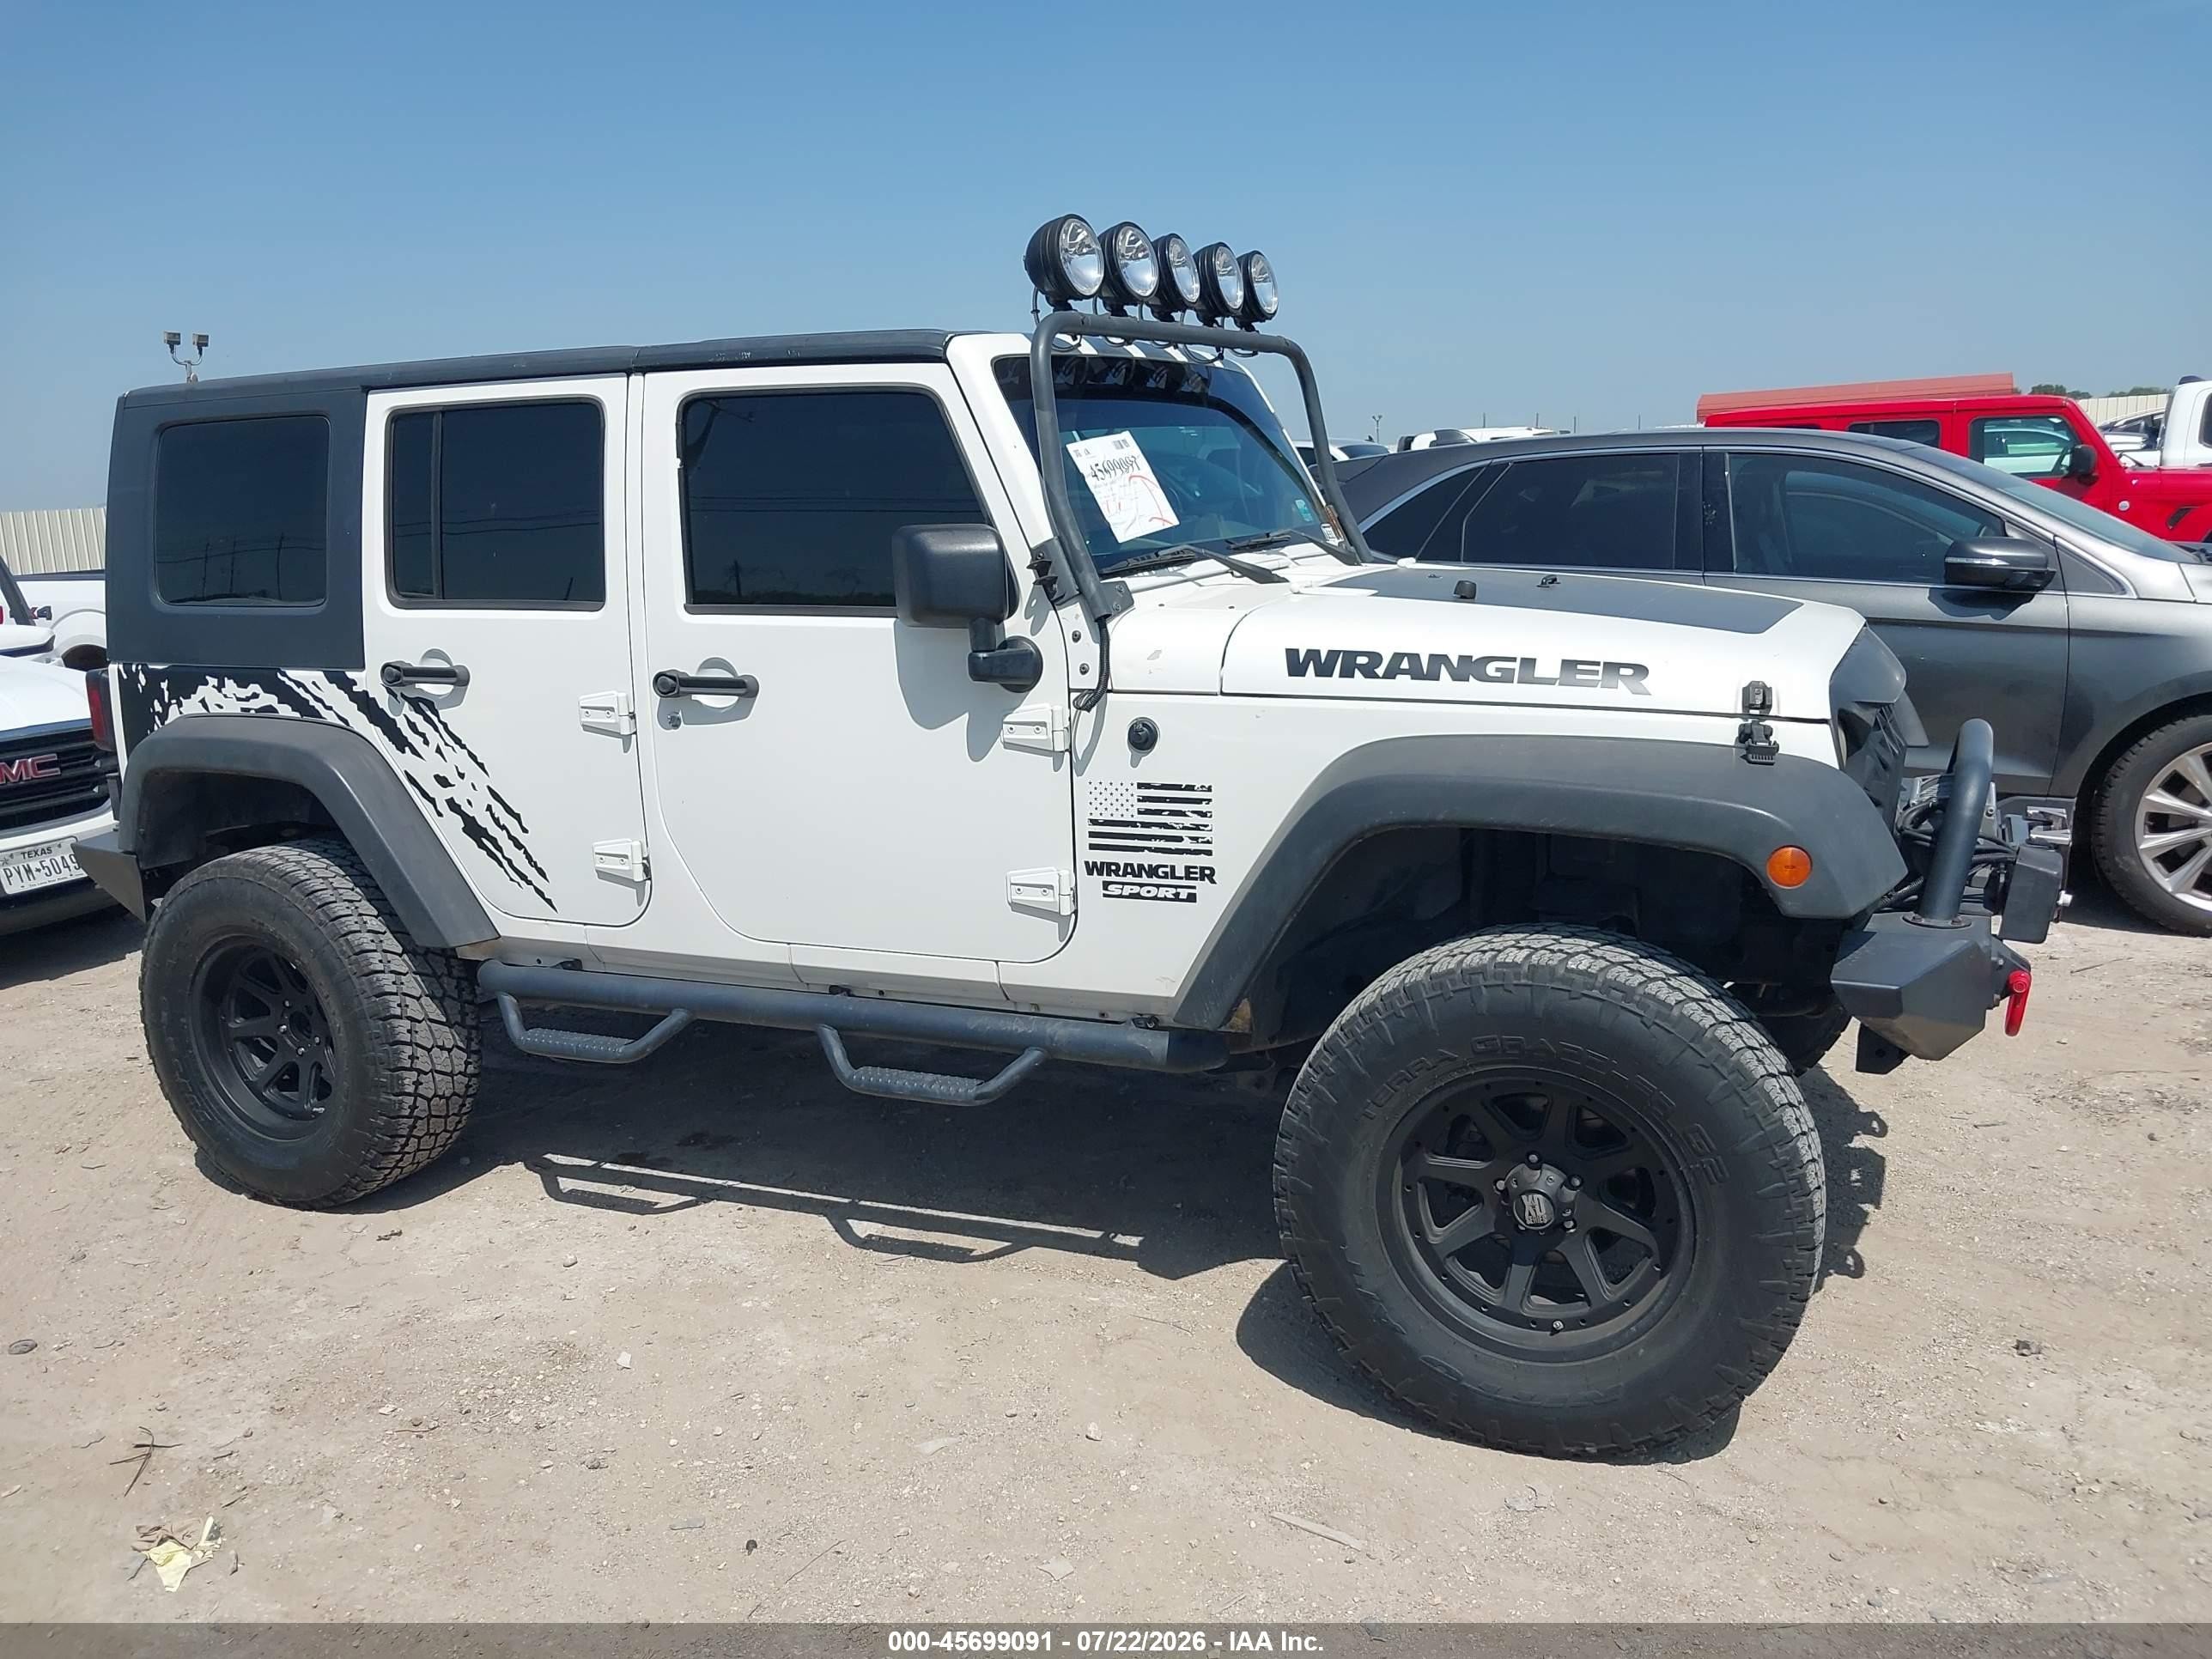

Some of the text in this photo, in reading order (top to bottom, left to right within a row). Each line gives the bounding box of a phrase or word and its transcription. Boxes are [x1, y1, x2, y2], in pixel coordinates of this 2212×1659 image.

[1285, 647, 1652, 696] WRANGLER
[21, 846, 52, 860] TEXAS
[1084, 860, 1217, 884] WRANGLER
[1103, 884, 1196, 899] SPORT
